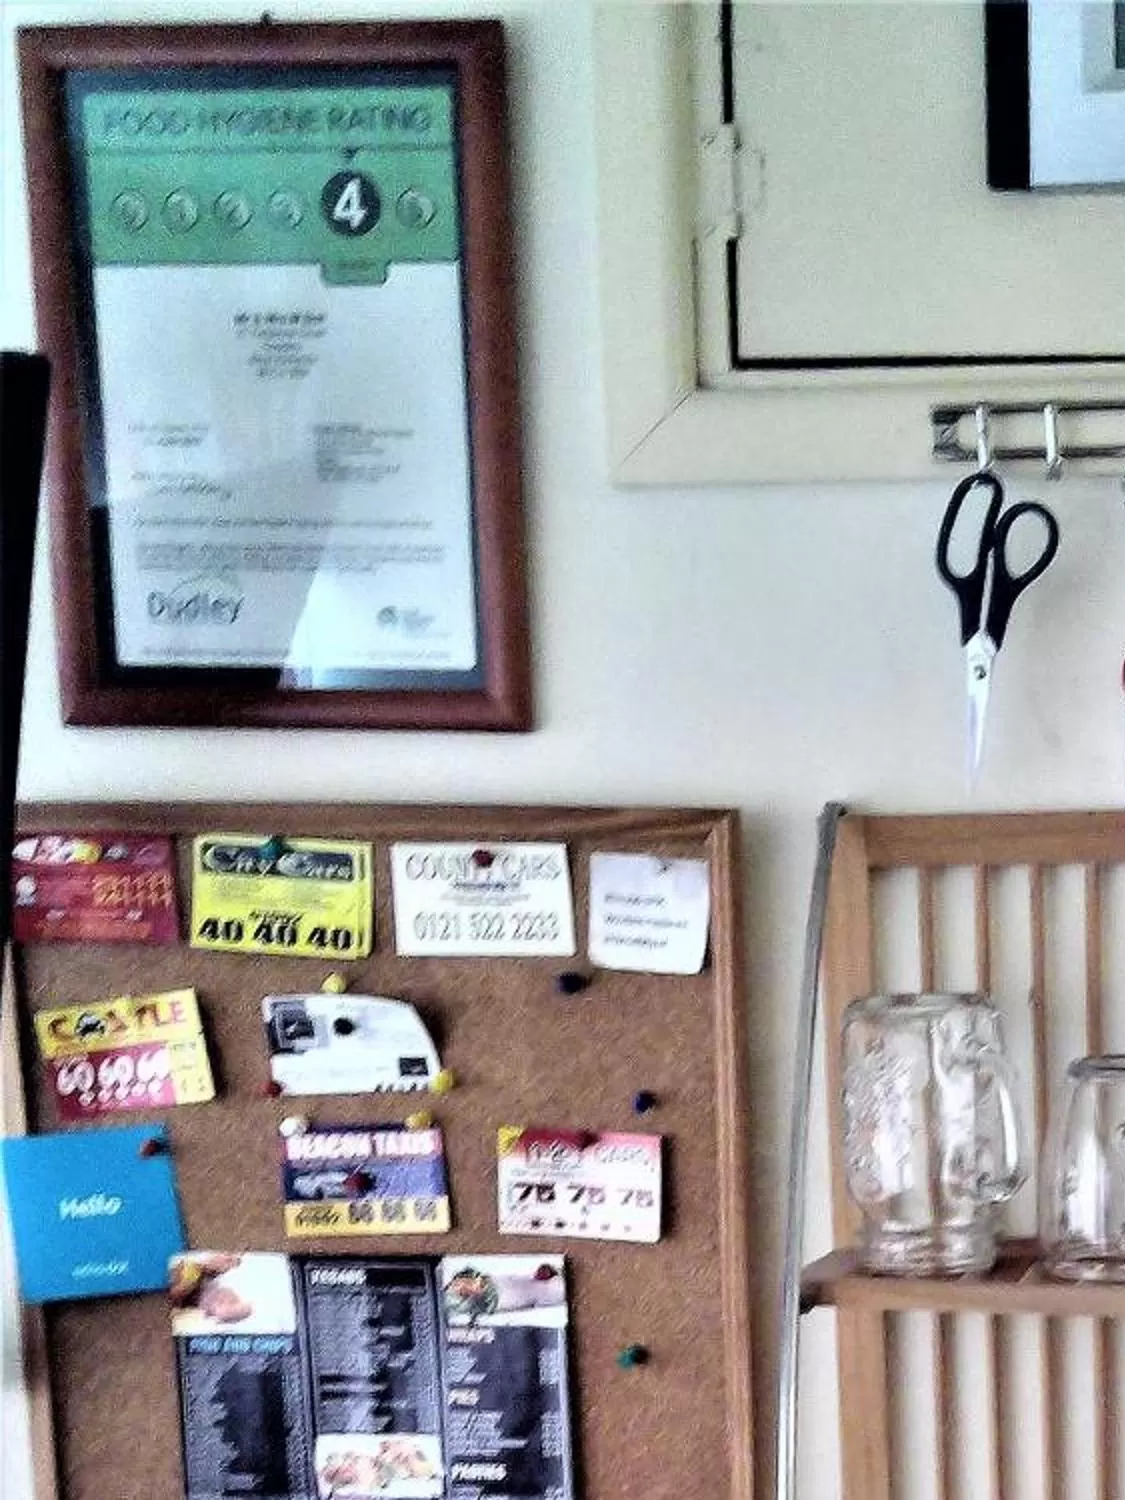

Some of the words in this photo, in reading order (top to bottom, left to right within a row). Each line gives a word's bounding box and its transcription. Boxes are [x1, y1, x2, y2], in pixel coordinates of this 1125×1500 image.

[327, 104, 433, 134] RATING
[332, 177, 367, 229] 4
[405, 850, 499, 882] COUNY
[198, 917, 244, 943] 40
[306, 926, 352, 950] 40
